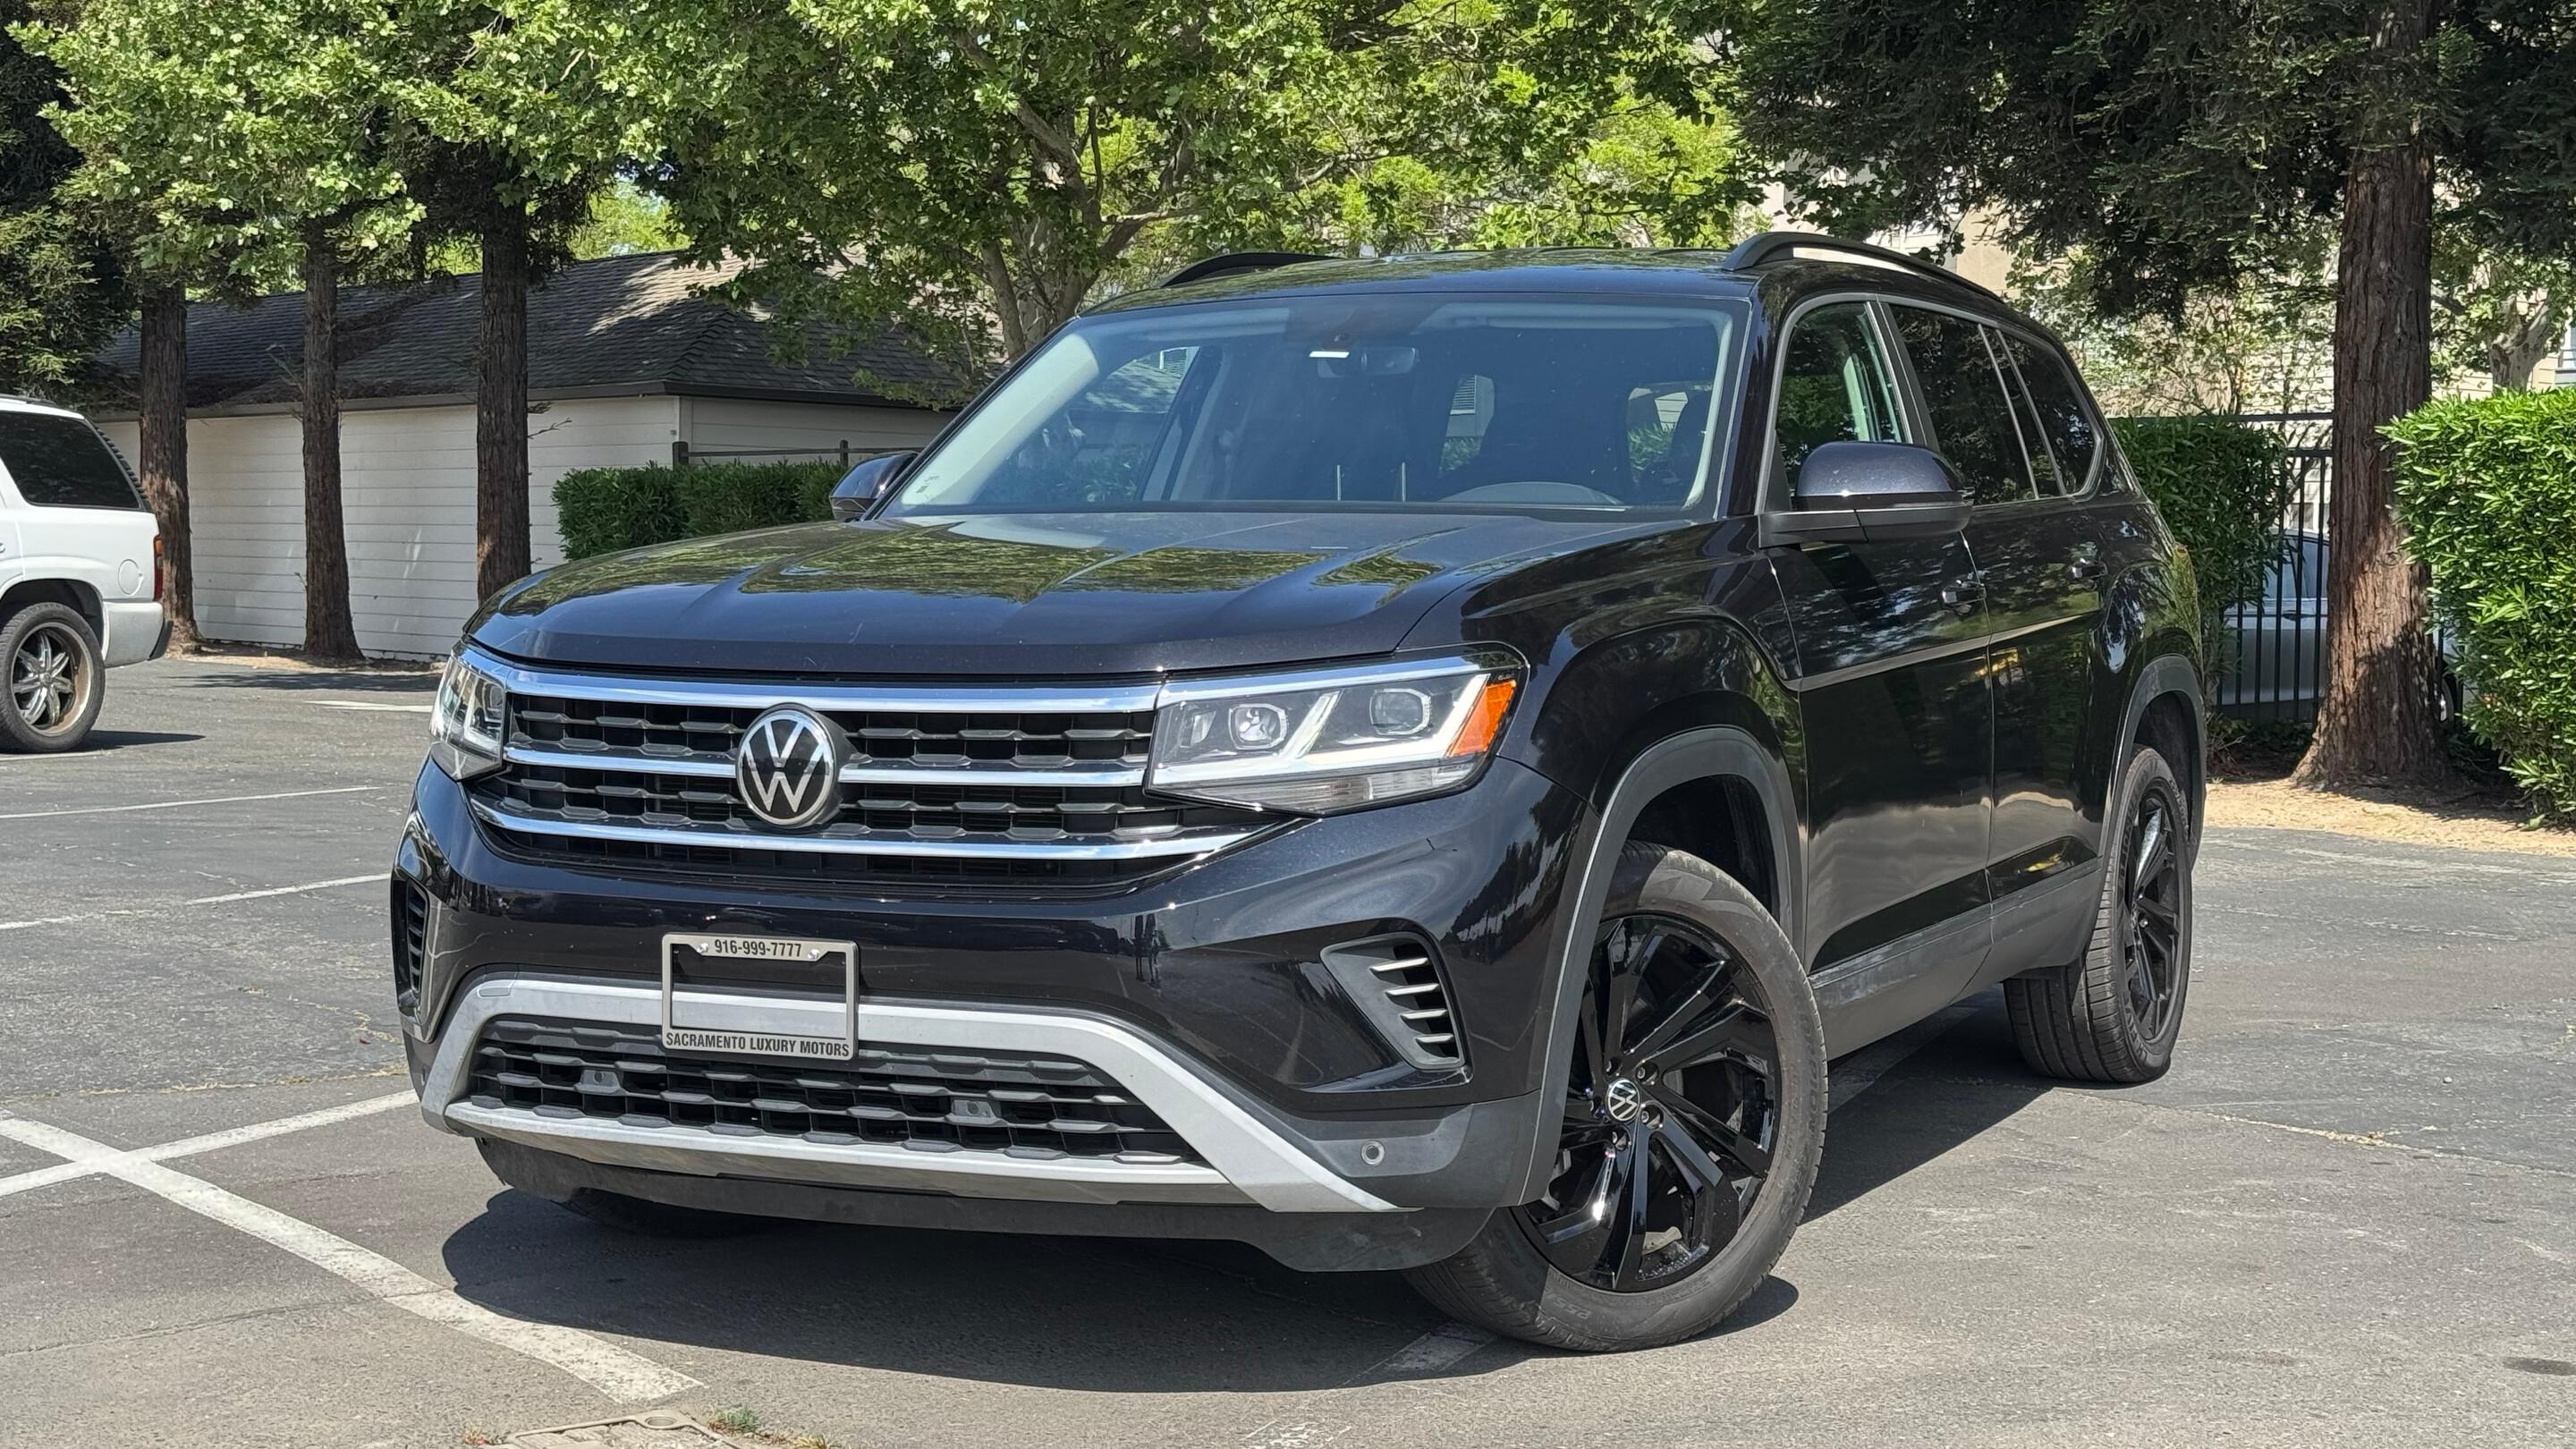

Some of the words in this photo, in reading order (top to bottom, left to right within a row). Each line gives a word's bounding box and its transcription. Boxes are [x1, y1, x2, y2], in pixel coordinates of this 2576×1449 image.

[715, 938, 801, 958] 916-999-7777
[666, 1032, 746, 1050] SACRAMENTO
[750, 1037, 796, 1053] LUXURY
[800, 1041, 850, 1057] MOTORS
